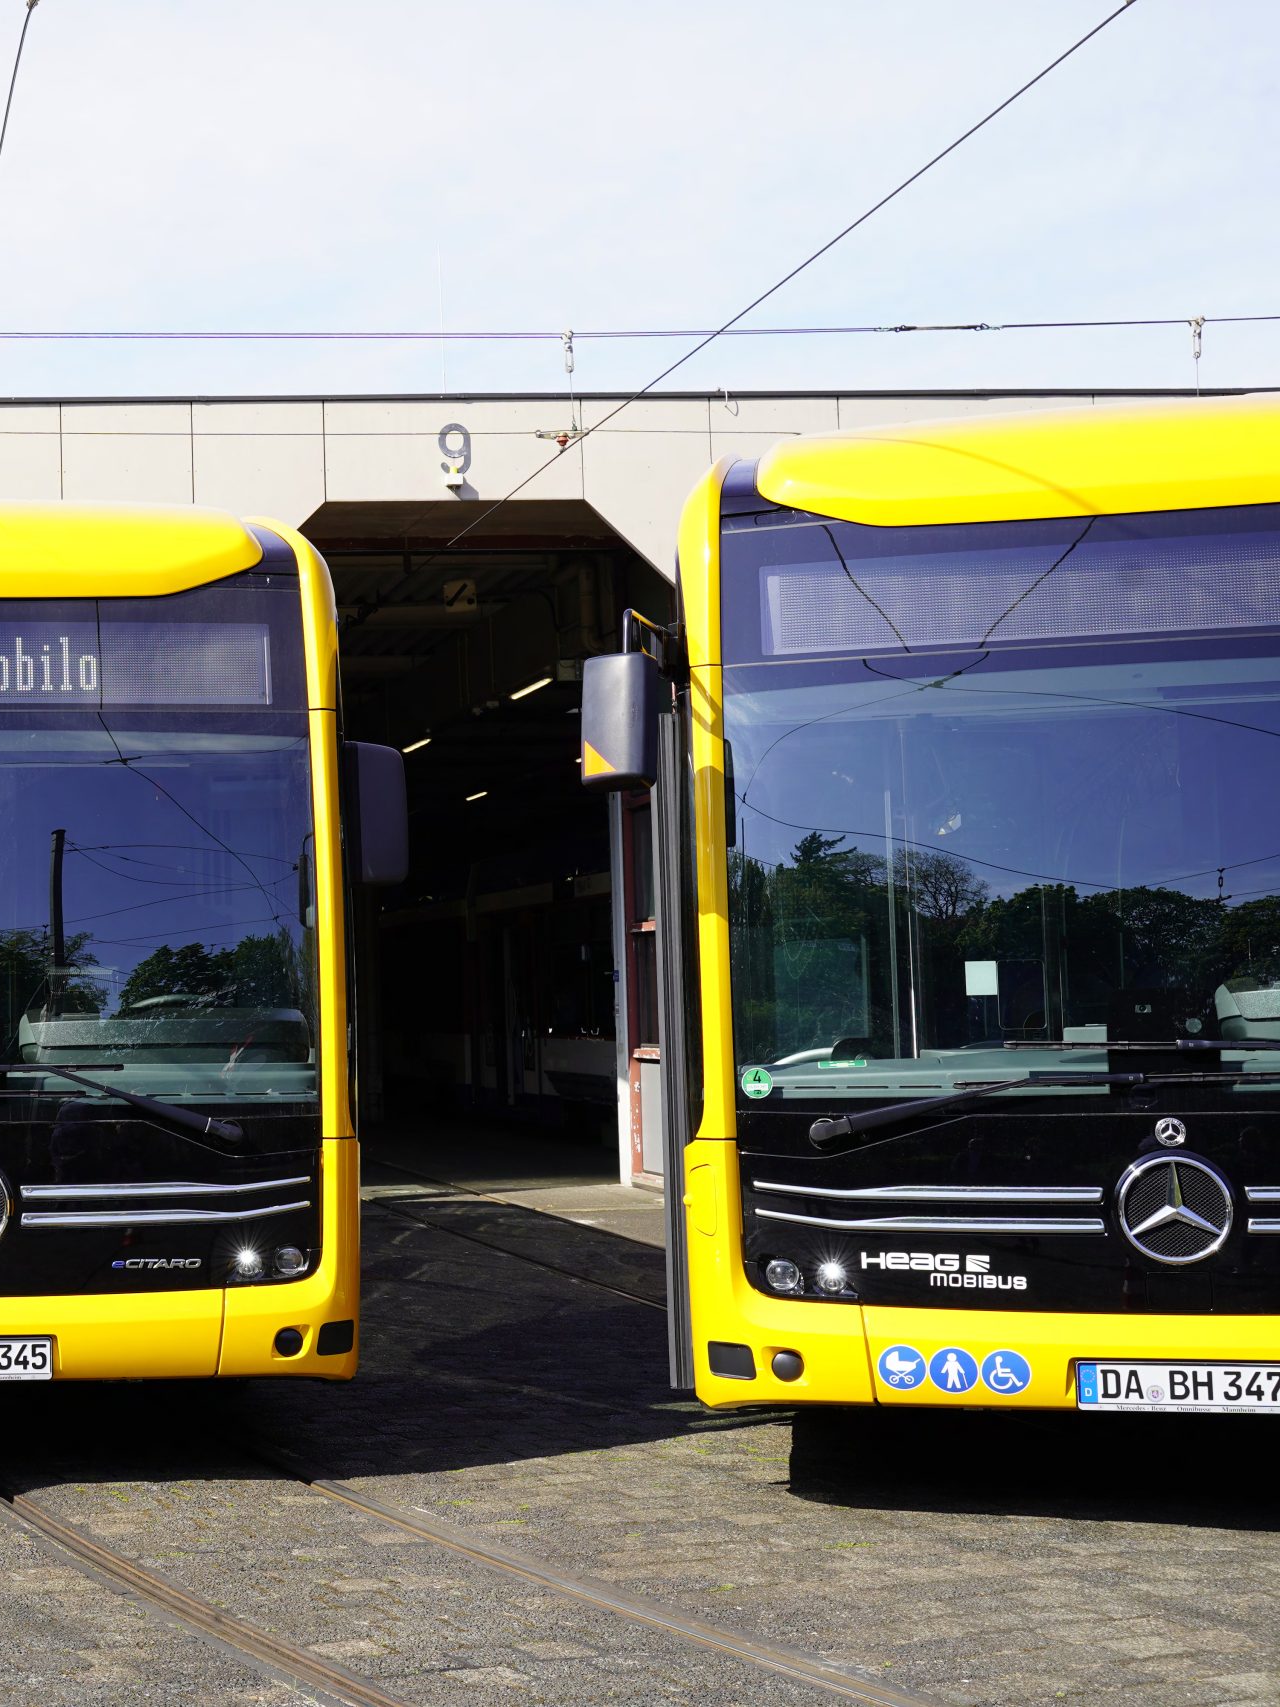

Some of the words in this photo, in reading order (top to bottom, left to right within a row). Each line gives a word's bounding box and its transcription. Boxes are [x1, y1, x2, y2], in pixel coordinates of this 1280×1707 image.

[438, 423, 471, 474] 9
[753, 1070, 762, 1083] 4
[111, 1258, 202, 1269] eCITARO
[1084, 1387, 1093, 1397] D
[1100, 1369, 1144, 1400] DA
[1169, 1370, 1214, 1401] BH
[1223, 1371, 1280, 1402] 347
